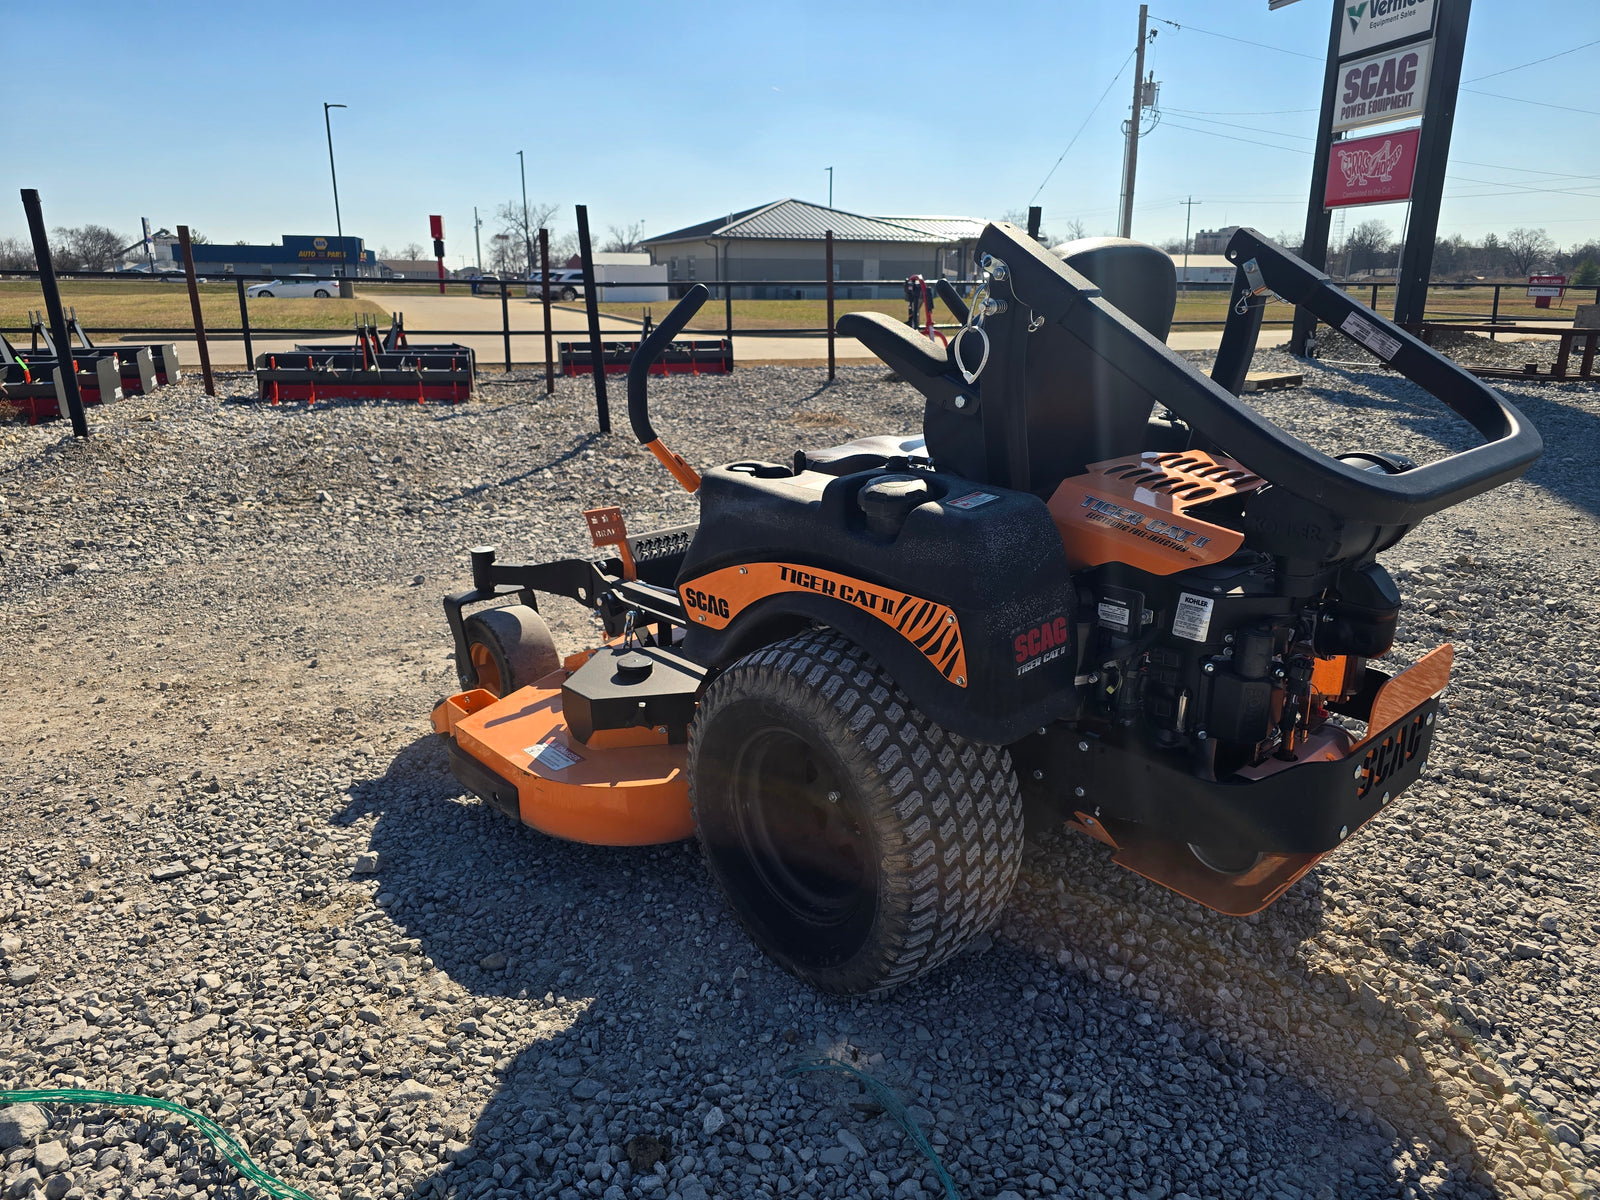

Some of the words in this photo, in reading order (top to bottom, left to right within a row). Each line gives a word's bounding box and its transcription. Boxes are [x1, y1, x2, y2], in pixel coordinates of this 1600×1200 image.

[1369, 14, 1399, 29] Equipment
[1400, 9, 1417, 20] Sales
[1343, 52, 1419, 105] SCAG
[1340, 102, 1367, 121] POWER
[1367, 92, 1414, 115] EQUIPMENT
[1081, 494, 1146, 526] TIGER
[1145, 519, 1197, 542] CAT
[1191, 535, 1211, 548] II
[1086, 511, 1130, 532] ELECTRONIC
[1128, 527, 1189, 552] FUEL-INJECTION
[685, 587, 730, 619] SCAG
[778, 565, 837, 597] TIGER
[839, 585, 882, 609] CAT
[881, 598, 895, 616] II
[1185, 596, 1209, 608] KOHLER
[1014, 616, 1067, 663] SCAG
[1016, 656, 1042, 676] TIGER
[1043, 647, 1061, 663] CAT
[1357, 713, 1424, 800] SCAG
